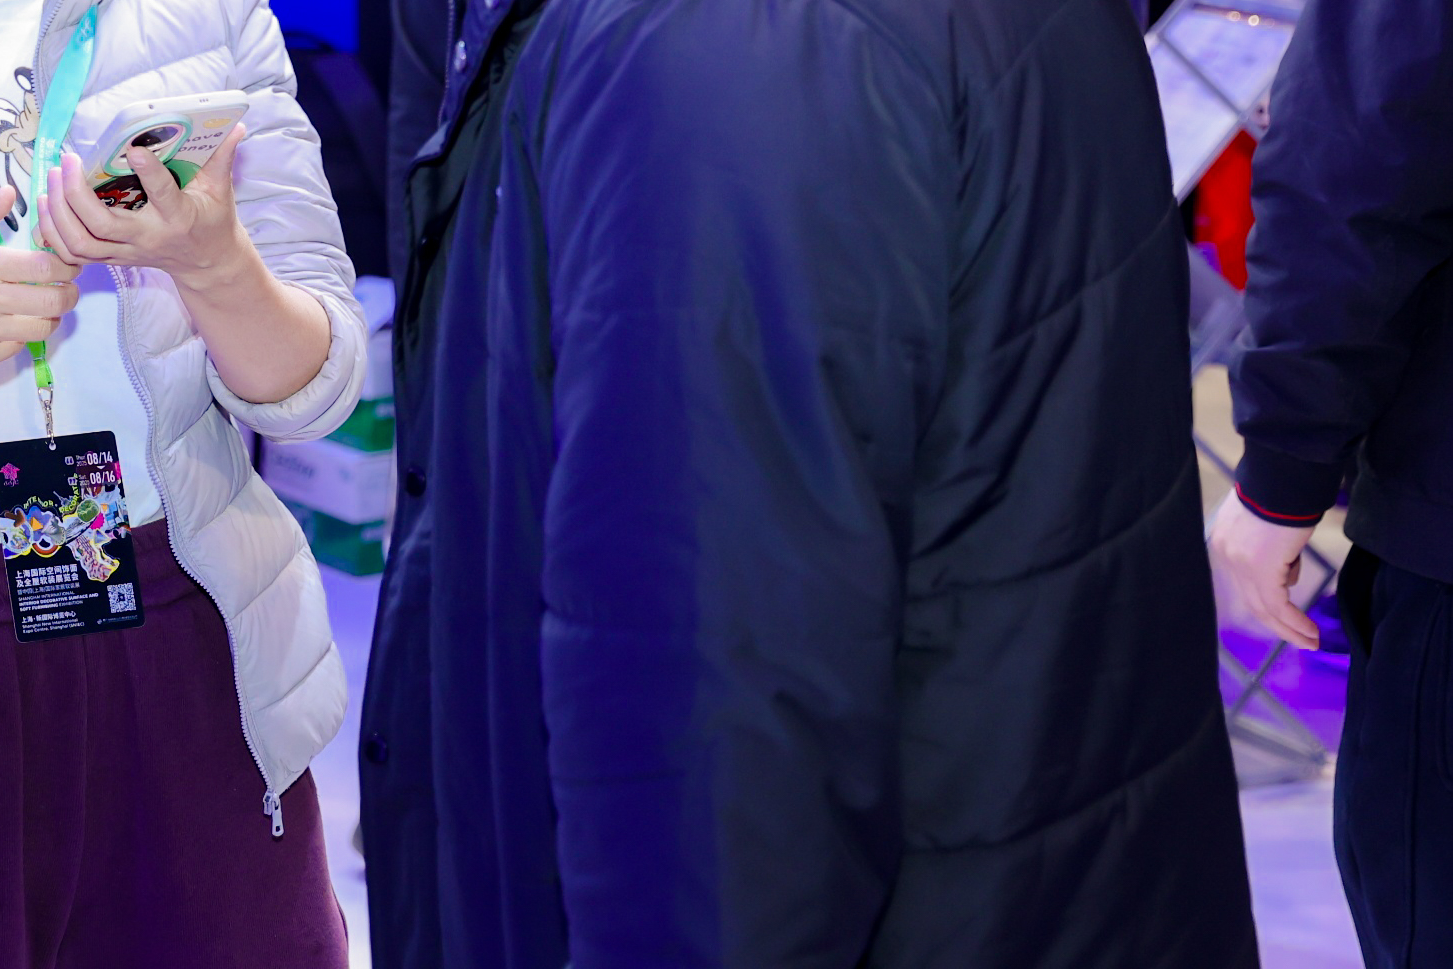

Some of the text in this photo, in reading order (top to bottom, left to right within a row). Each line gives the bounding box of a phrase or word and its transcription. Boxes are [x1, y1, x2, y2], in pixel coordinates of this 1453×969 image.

[178, 144, 218, 153] oney
[87, 451, 113, 465] 08/14
[90, 470, 115, 484] 08/16
